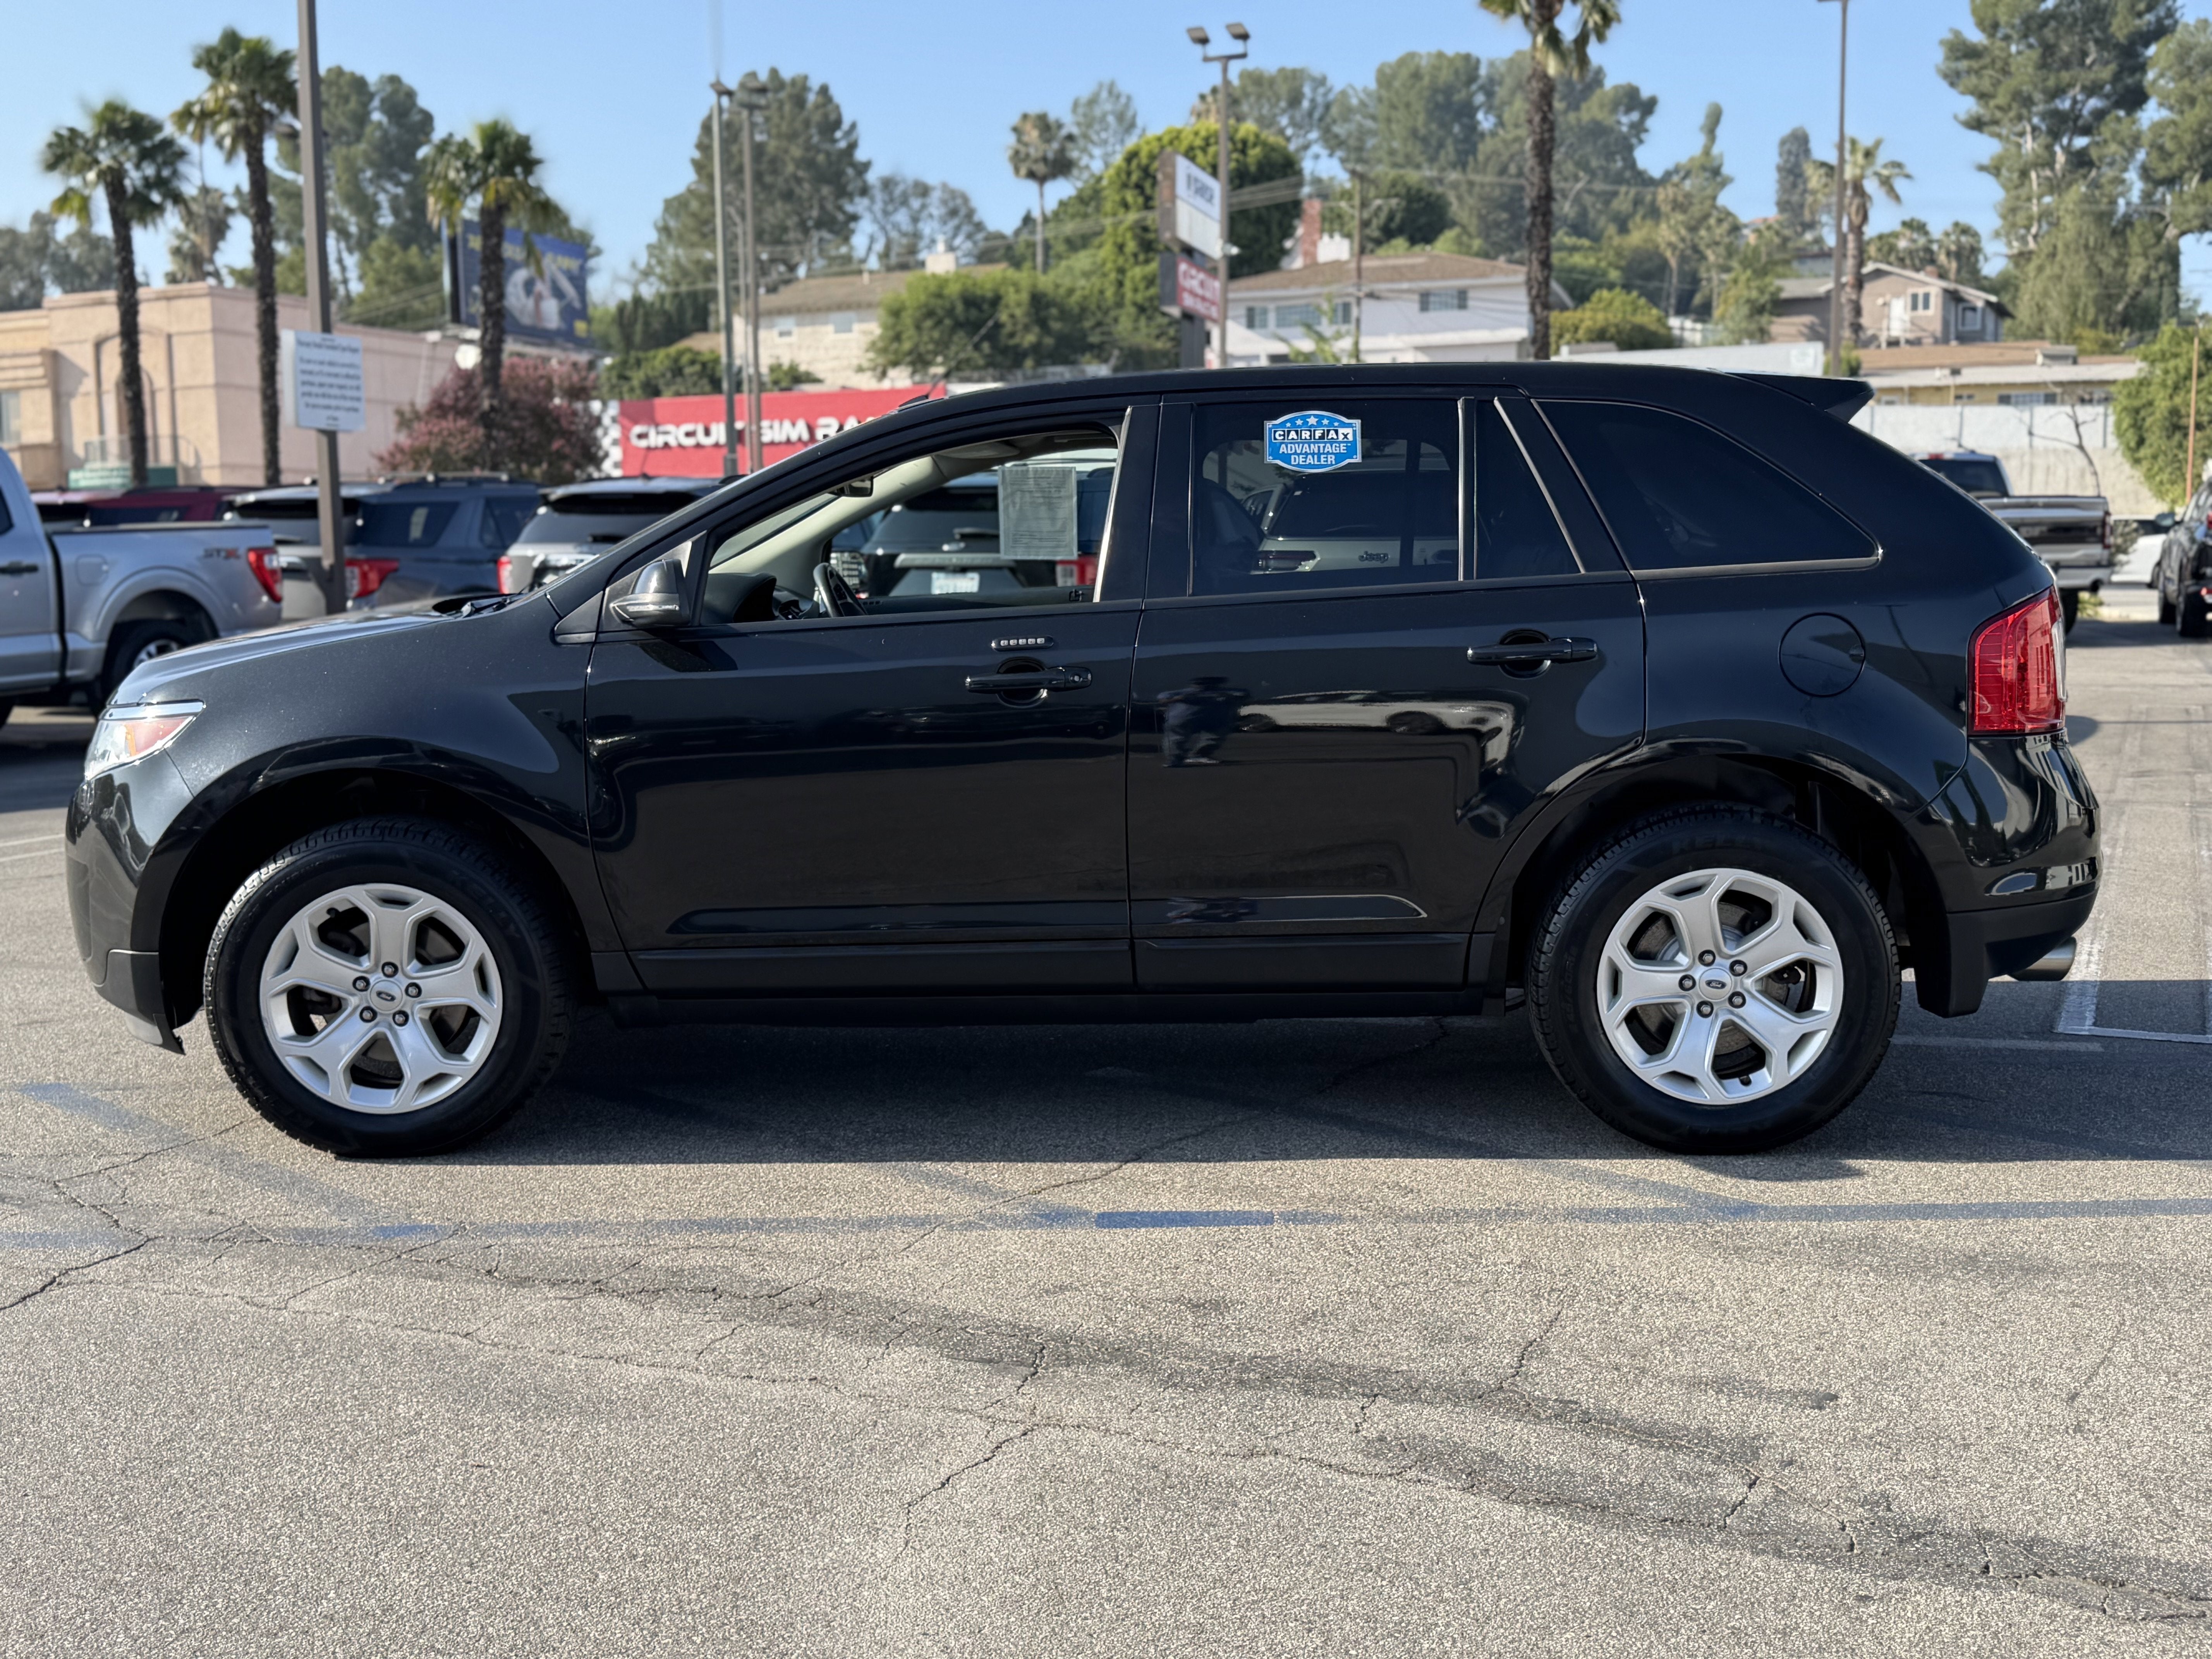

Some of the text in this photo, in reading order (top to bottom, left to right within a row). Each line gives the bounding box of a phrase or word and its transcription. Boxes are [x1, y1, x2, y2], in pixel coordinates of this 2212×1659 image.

[760, 417, 811, 443] SIM
[1274, 429, 1351, 440] CARFAX
[1279, 443, 1347, 453] ADVANTAGE
[1291, 455, 1335, 465] DEALER
[1358, 551, 1389, 563] Jeep
